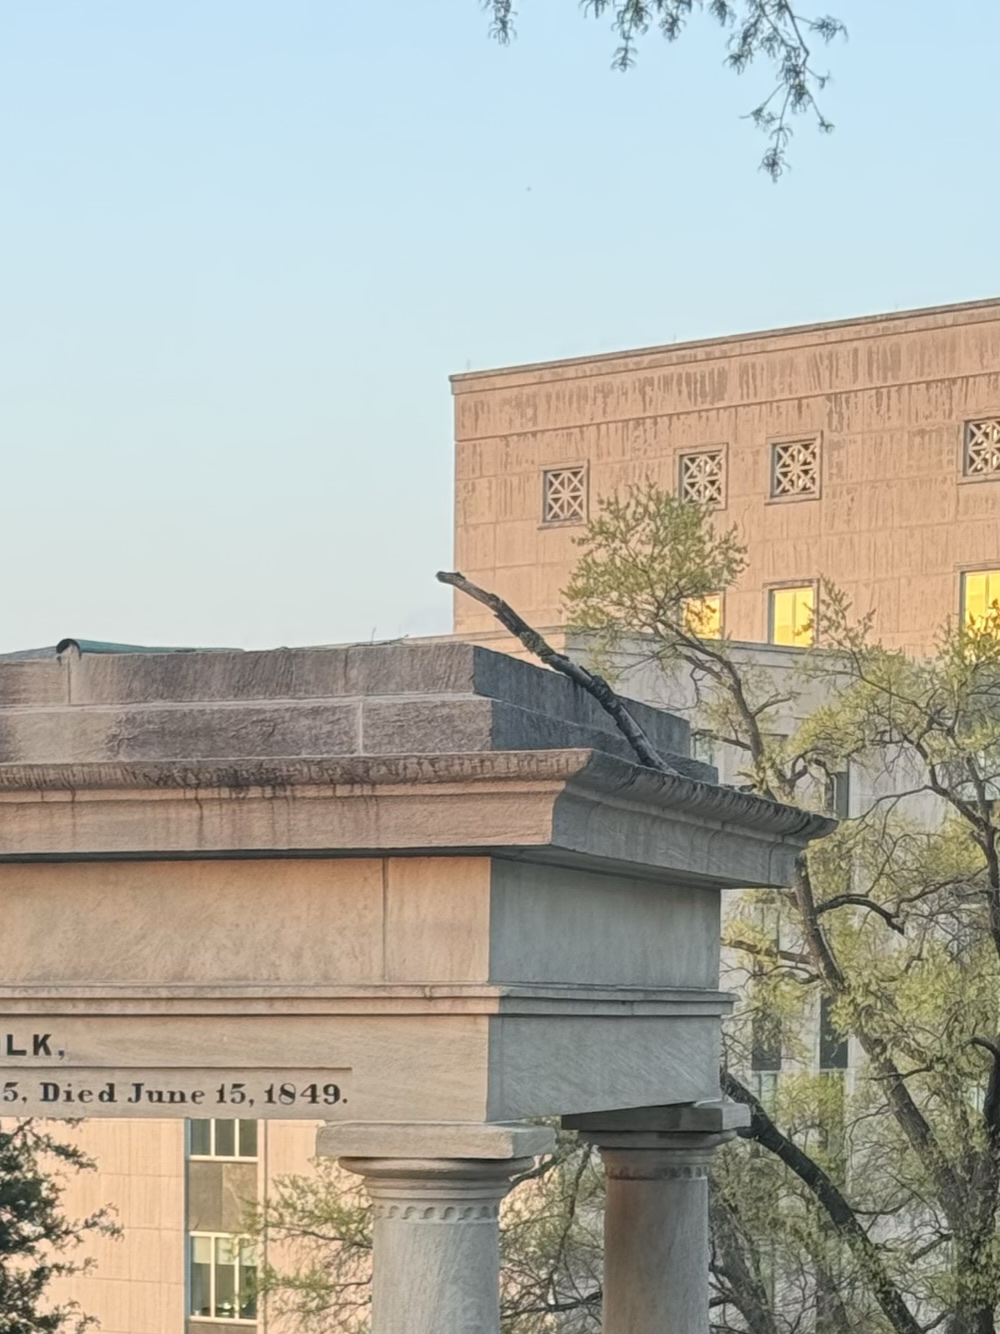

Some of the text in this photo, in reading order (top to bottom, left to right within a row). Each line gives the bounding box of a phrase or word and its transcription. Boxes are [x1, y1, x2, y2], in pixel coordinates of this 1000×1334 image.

[40, 1082, 116, 1103] Died
[127, 1082, 205, 1105] June
[216, 1083, 254, 1107] 15,
[264, 1083, 349, 1106] 1849.
